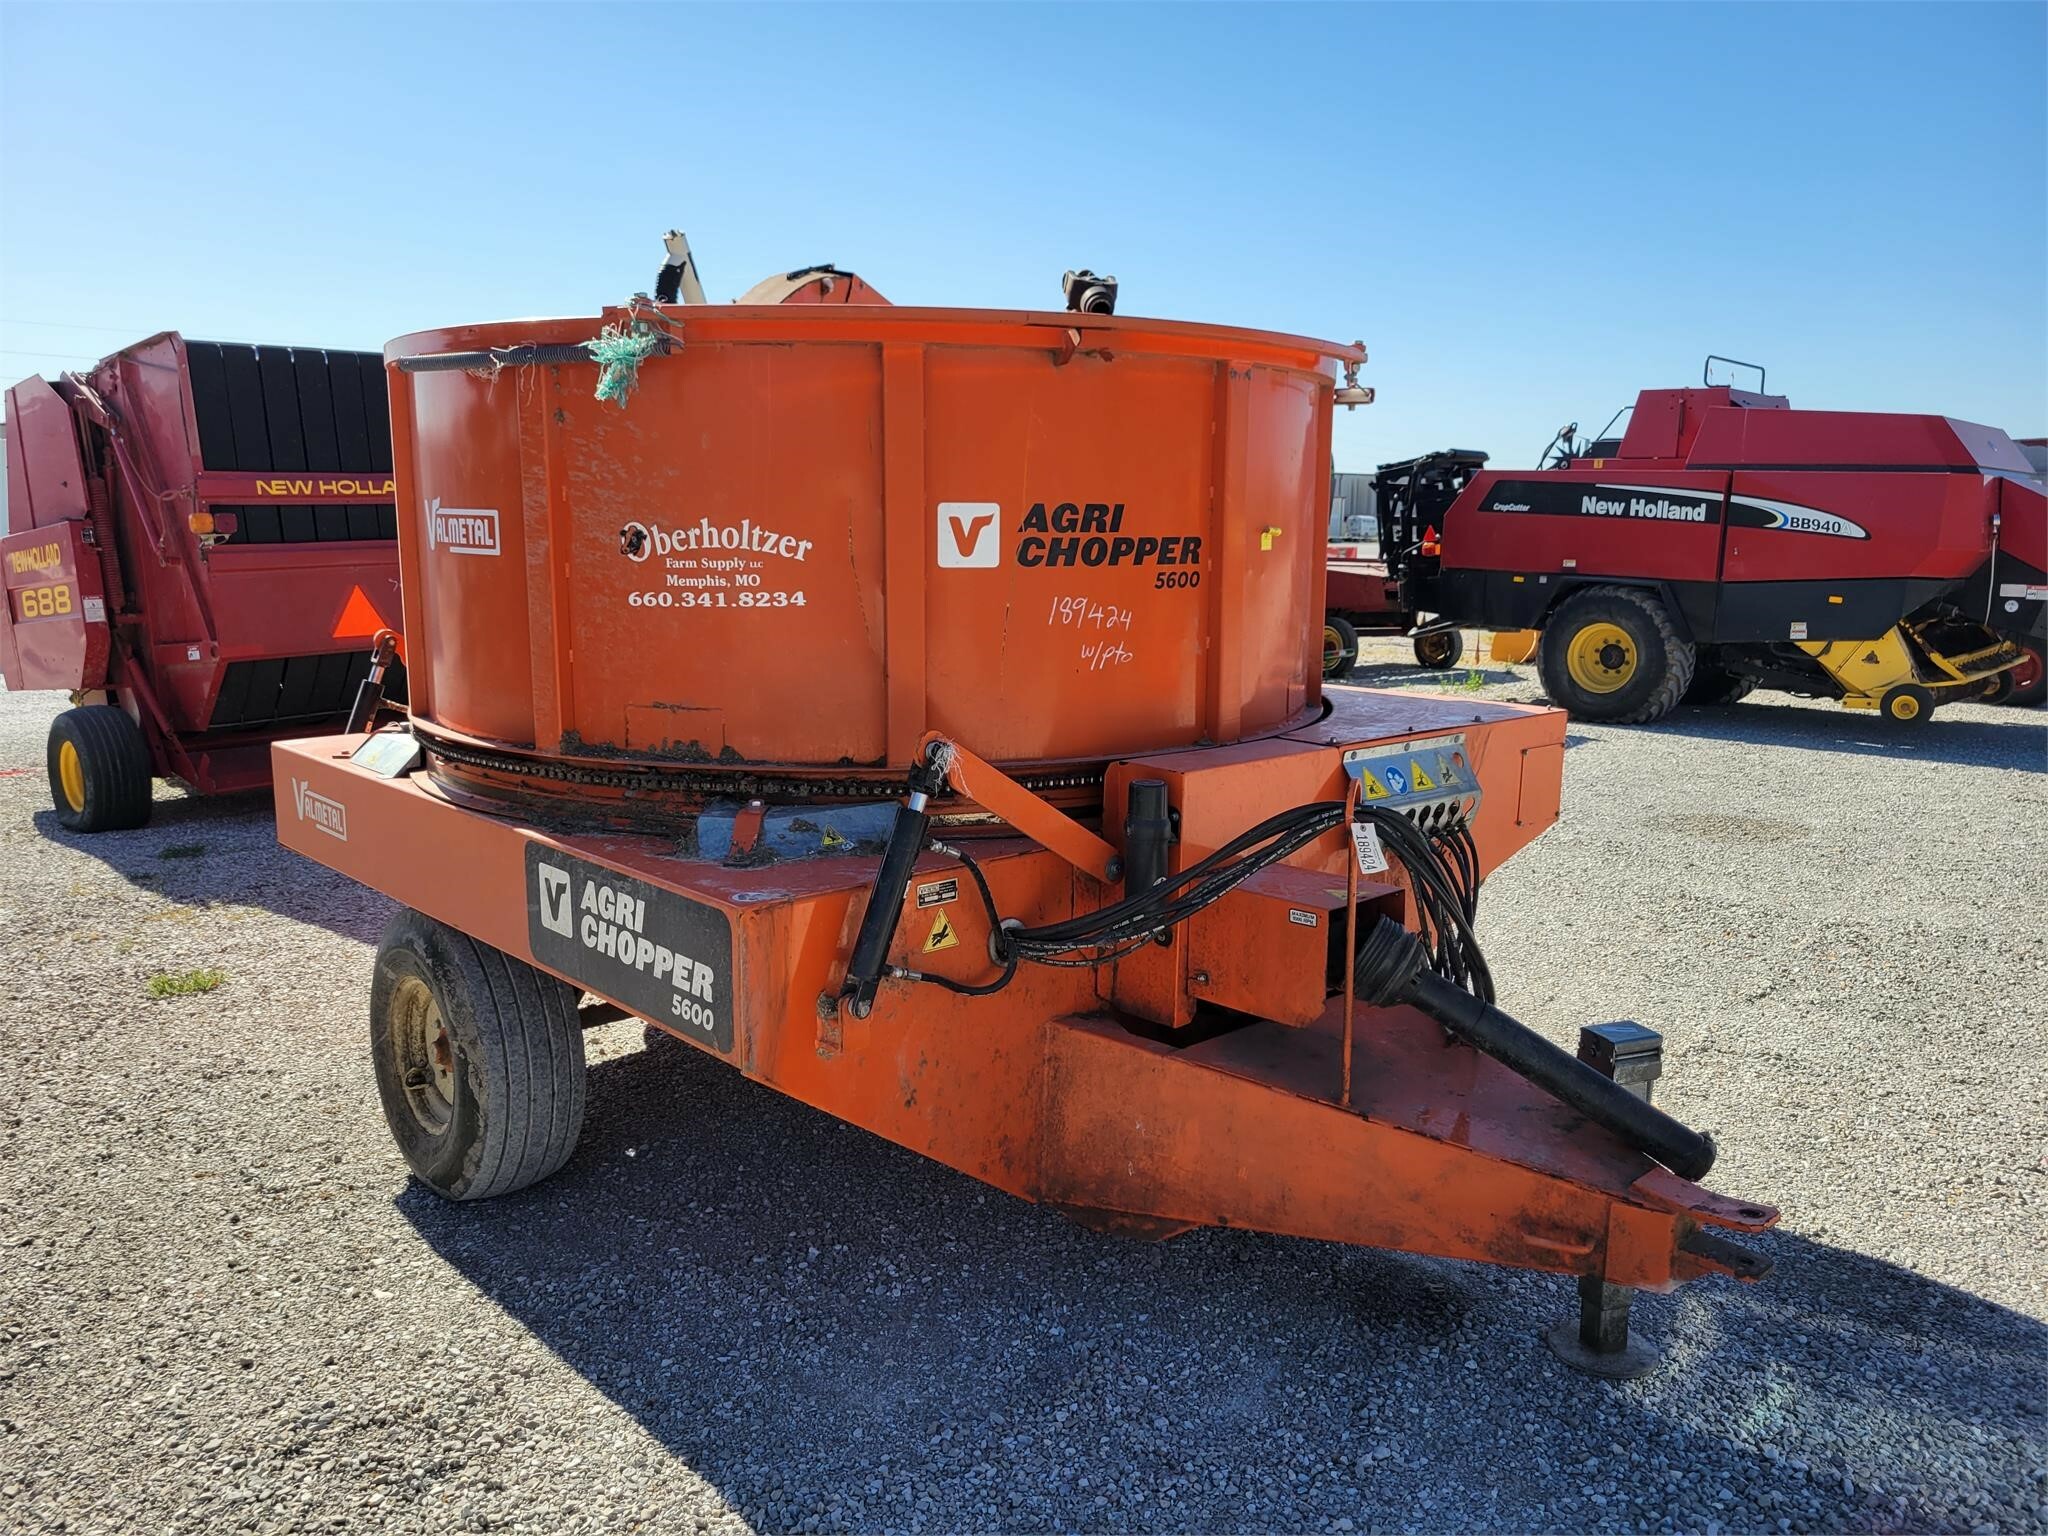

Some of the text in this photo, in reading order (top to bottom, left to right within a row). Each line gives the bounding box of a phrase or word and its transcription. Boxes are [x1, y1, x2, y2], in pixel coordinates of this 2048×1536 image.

[256, 480, 395, 495] NEW HOLLA
[424, 496, 494, 551] VALMETAL
[1018, 503, 1125, 533] AGRI
[1493, 502, 1530, 512] CropCutter
[1582, 495, 1706, 521] New Holland
[621, 517, 812, 562] Oberholtzer
[1016, 536, 1201, 568] CHOPPER
[666, 557, 697, 568] Farm
[701, 557, 746, 571] Supply
[1154, 571, 1201, 589] 5600
[666, 574, 761, 589] Memphis, MO
[22, 584, 72, 618] 688
[628, 591, 807, 607] 660.341.8234
[1048, 597, 1132, 631] 189424
[291, 777, 343, 832] VALMETAL
[1356, 834, 1378, 871] 189424
[580, 880, 645, 933] AGRI
[581, 914, 714, 1003] CHOPPER
[671, 994, 714, 1031] 5600
